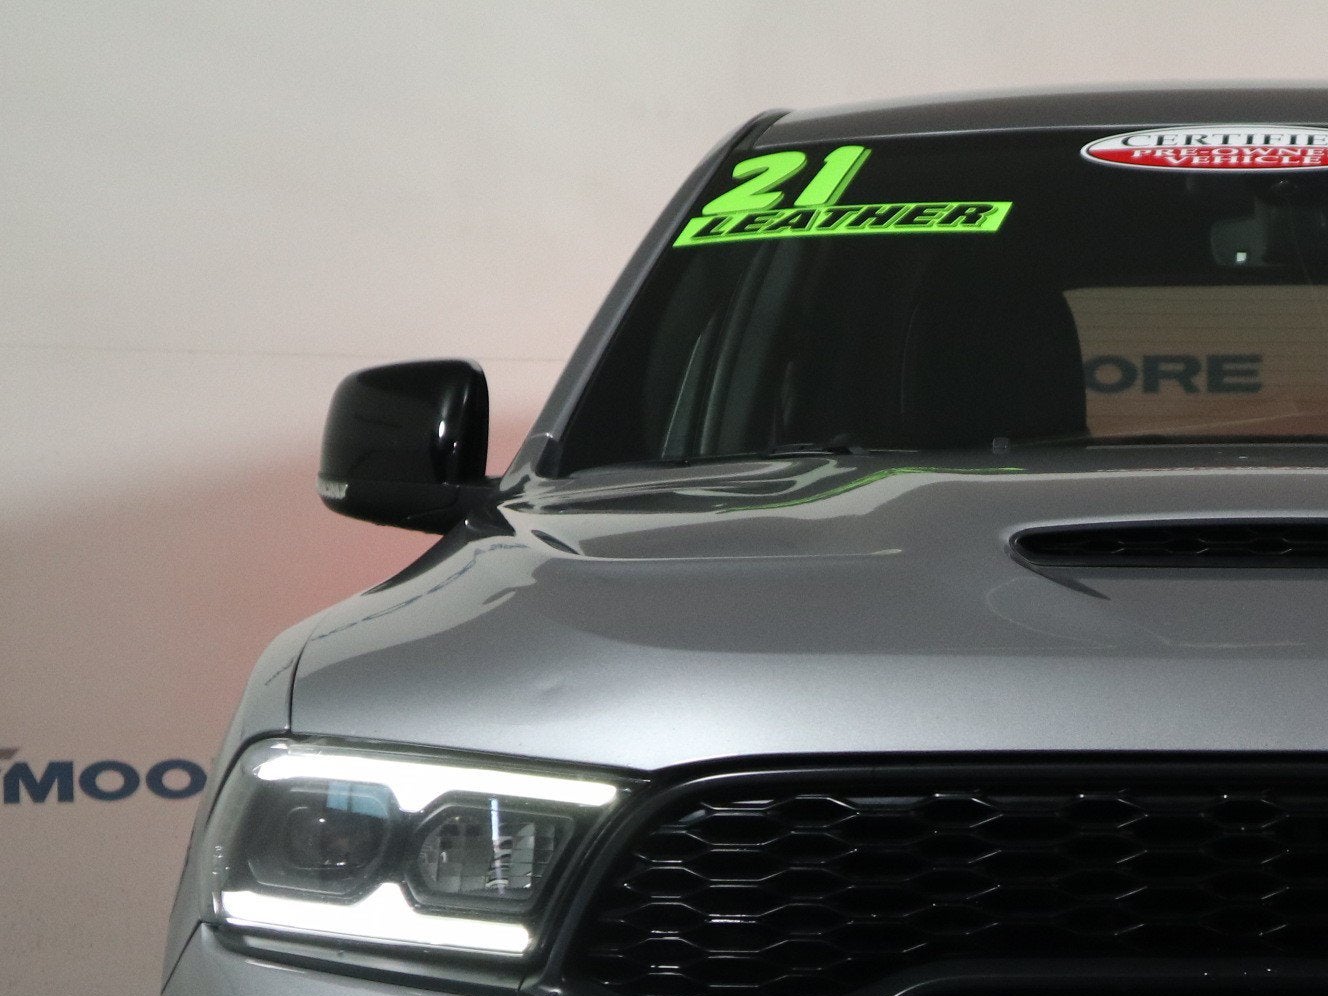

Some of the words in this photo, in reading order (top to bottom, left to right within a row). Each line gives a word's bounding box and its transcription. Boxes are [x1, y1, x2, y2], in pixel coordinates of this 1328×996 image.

[1166, 155, 1322, 165] VEHICLE
[702, 145, 872, 215] 21
[690, 202, 998, 238] LEATHER
